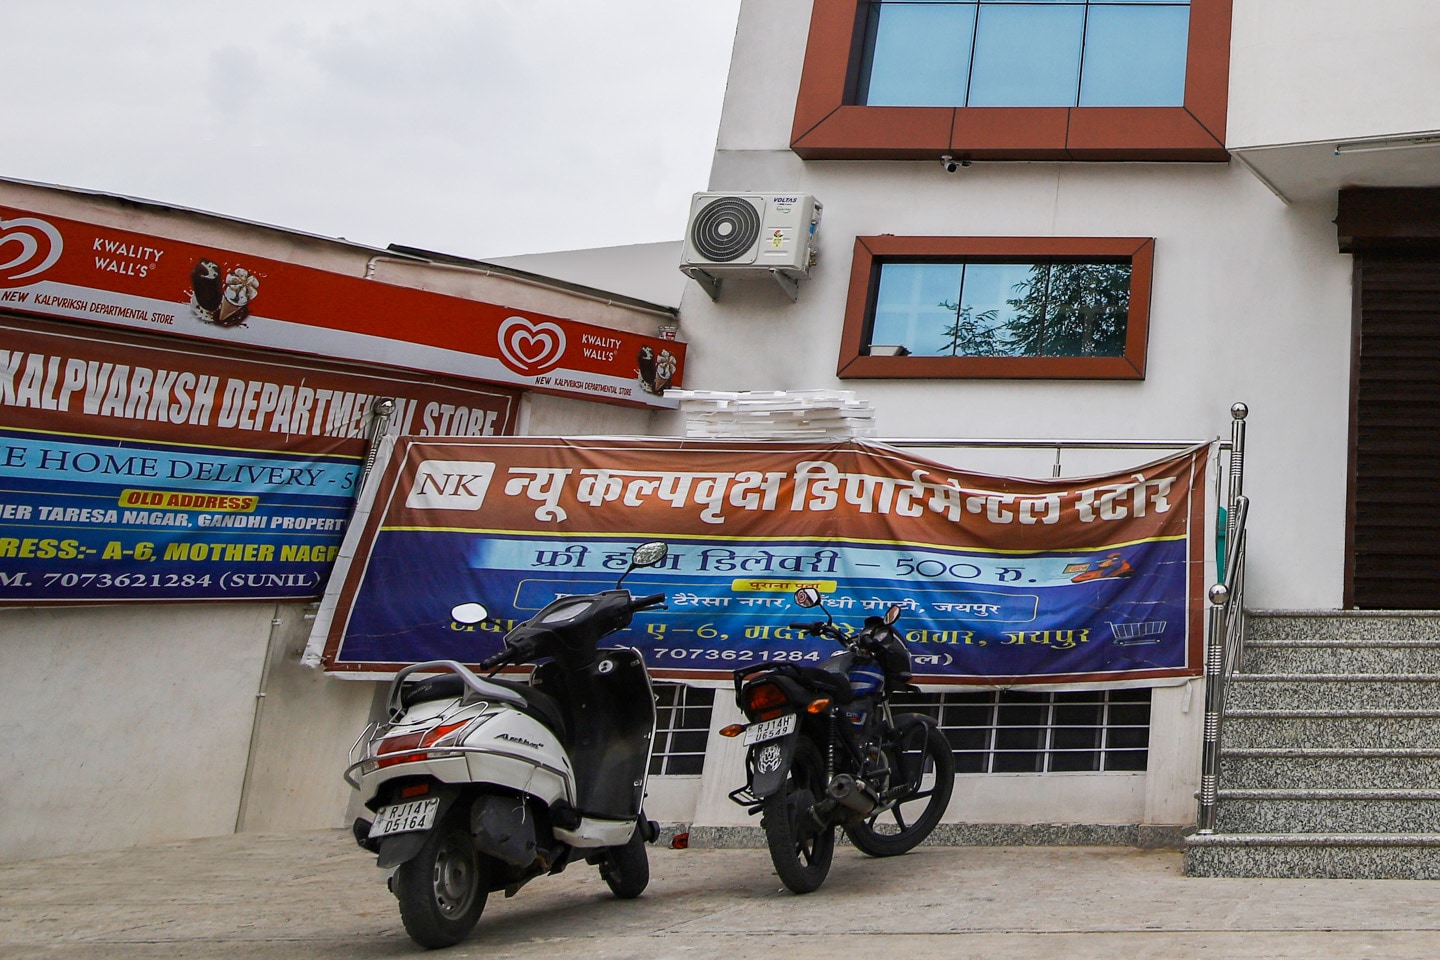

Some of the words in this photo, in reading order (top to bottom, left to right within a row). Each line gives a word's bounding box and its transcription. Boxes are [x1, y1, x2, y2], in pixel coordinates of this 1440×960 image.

[93, 237, 164, 262] KWALITY
[94, 256, 149, 279] WALL'S
[1, 290, 29, 303] NEW
[89, 302, 149, 322] DEPARTMENTAL
[151, 311, 174, 326] STORE
[581, 333, 622, 350] KWALITY
[583, 347, 614, 363] WALL'S
[0, 350, 220, 427] KALPVARKSH
[217, 378, 419, 441] DEPARTMENAL
[535, 376, 552, 385] NEW
[584, 381, 618, 394] DEPARTMENTAL
[619, 387, 632, 397] STORE
[36, 448, 159, 478] HOME
[166, 458, 325, 487] DELIVERY
[416, 472, 484, 498] NK
[504, 467, 573, 523] न्यू
[577, 468, 787, 524] कल्पवृक्ष
[790, 459, 1068, 525] डिपार्टमेन्टल
[1074, 473, 1177, 523] स्टोर
[127, 492, 164, 506] OLD
[167, 494, 253, 510] ADDRESS
[38, 506, 118, 524] TARESA
[122, 510, 192, 528] NAGAR,
[198, 514, 267, 528] GANDHI
[163, 543, 276, 562] MOTHER
[531, 544, 592, 568] फ्री
[696, 548, 841, 573] डिलेवरी
[896, 557, 982, 579] 500
[43, 572, 212, 588] 7073621284
[219, 571, 321, 590] (SUNIL)
[749, 581, 791, 591] पुराना
[736, 597, 791, 610] नगर,
[932, 602, 1002, 616] जयपुर
[1000, 627, 1093, 650] जयपुर
[654, 648, 820, 662] 7073621284
[757, 716, 790, 733] RJ14H
[389, 801, 431, 819] RJ14Y
